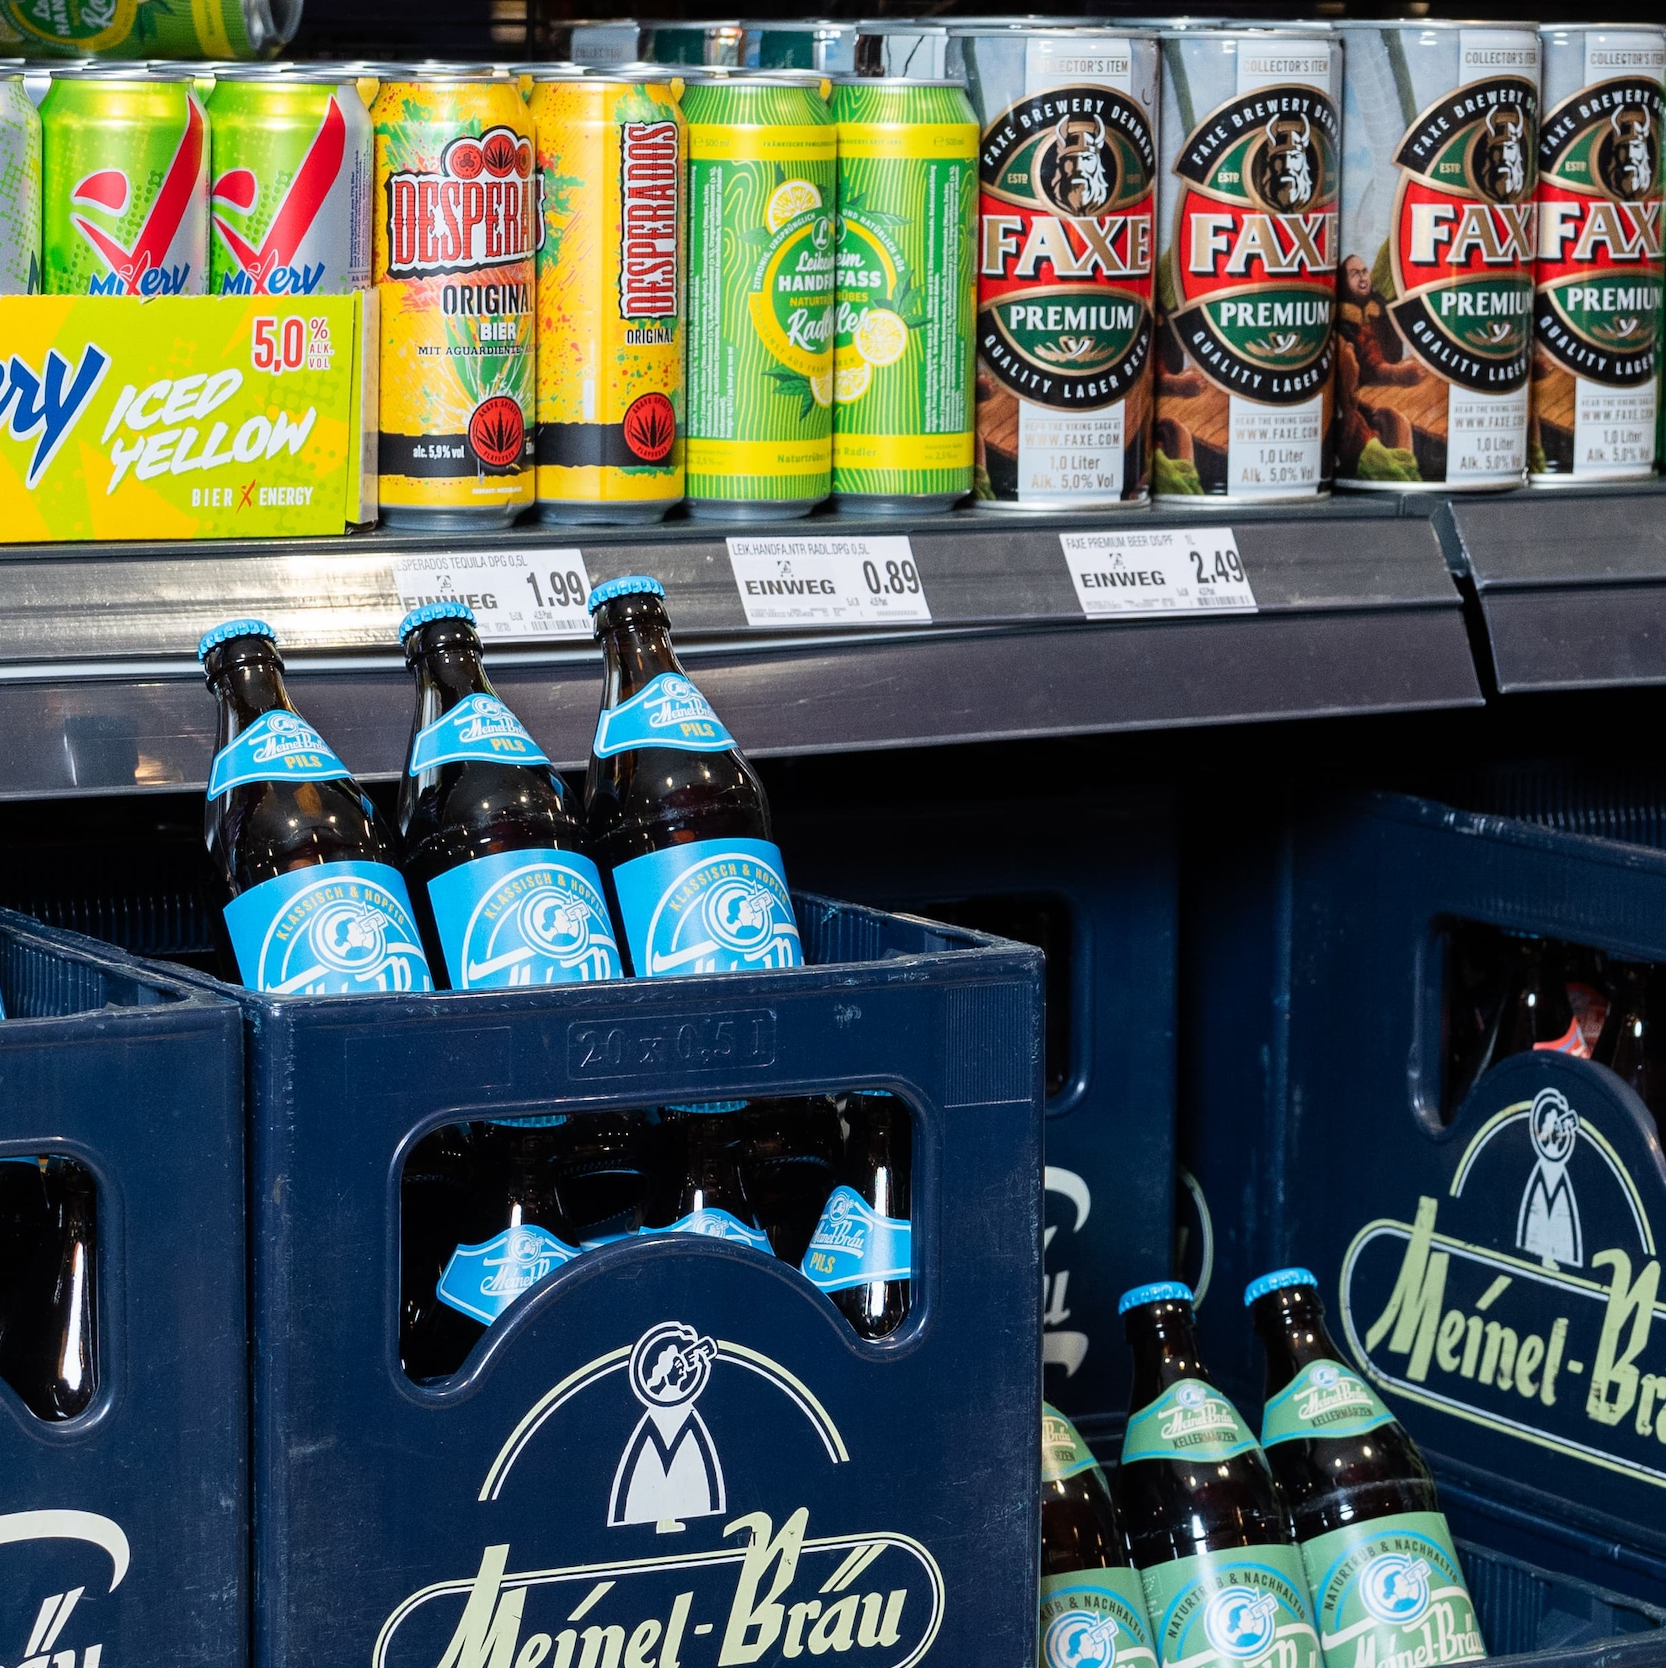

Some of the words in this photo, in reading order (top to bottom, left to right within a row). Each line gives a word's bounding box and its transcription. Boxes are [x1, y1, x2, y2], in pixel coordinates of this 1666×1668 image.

[1412, 116, 1451, 158] FAXE
[1453, 88, 1524, 120] BREWERY
[626, 123, 678, 316] DESPERADOS
[841, 208, 859, 221] UND
[981, 214, 1153, 278] FAXE
[1010, 305, 1134, 332] PREMIUM
[1220, 300, 1331, 328] PREMIUM
[251, 317, 304, 374] 5,0
[626, 328, 674, 345] ORIGINAL
[1412, 319, 1482, 379] QUALITY
[308, 356, 331, 370] VOL
[1063, 374, 1121, 400] LAGER
[101, 368, 244, 446] ICED
[105, 407, 317, 496] YELLOW
[413, 445, 428, 459] alc.
[429, 445, 450, 460] 5,9%
[1024, 433, 1121, 448] WWW.FAXE.COM
[1071, 455, 1101, 472] Liter
[1060, 473, 1094, 491] 5,0%
[190, 487, 234, 508] BIER
[258, 485, 314, 507] ENERGY
[851, 542, 871, 556] 0,5L
[1065, 537, 1087, 550] FAXE
[1087, 536, 1127, 549] PREMIUM
[1127, 534, 1148, 547] BEER
[449, 555, 487, 570] TEQUILA
[487, 554, 507, 566] DPG
[508, 553, 529, 567] 0,5L
[1189, 549, 1245, 585] 2.49
[525, 570, 587, 608] 1.99
[744, 578, 837, 596] EINWEG
[861, 559, 921, 596] 0.89
[1079, 570, 1167, 588] EINWEG
[678, 721, 716, 739] PILS
[490, 736, 527, 753] PILS
[284, 753, 324, 770] PILS
[484, 872, 553, 921] KLASSISCH
[669, 861, 739, 913] KLASSISCH
[276, 886, 344, 942] KLASSISCH
[579, 1028, 626, 1068] 20
